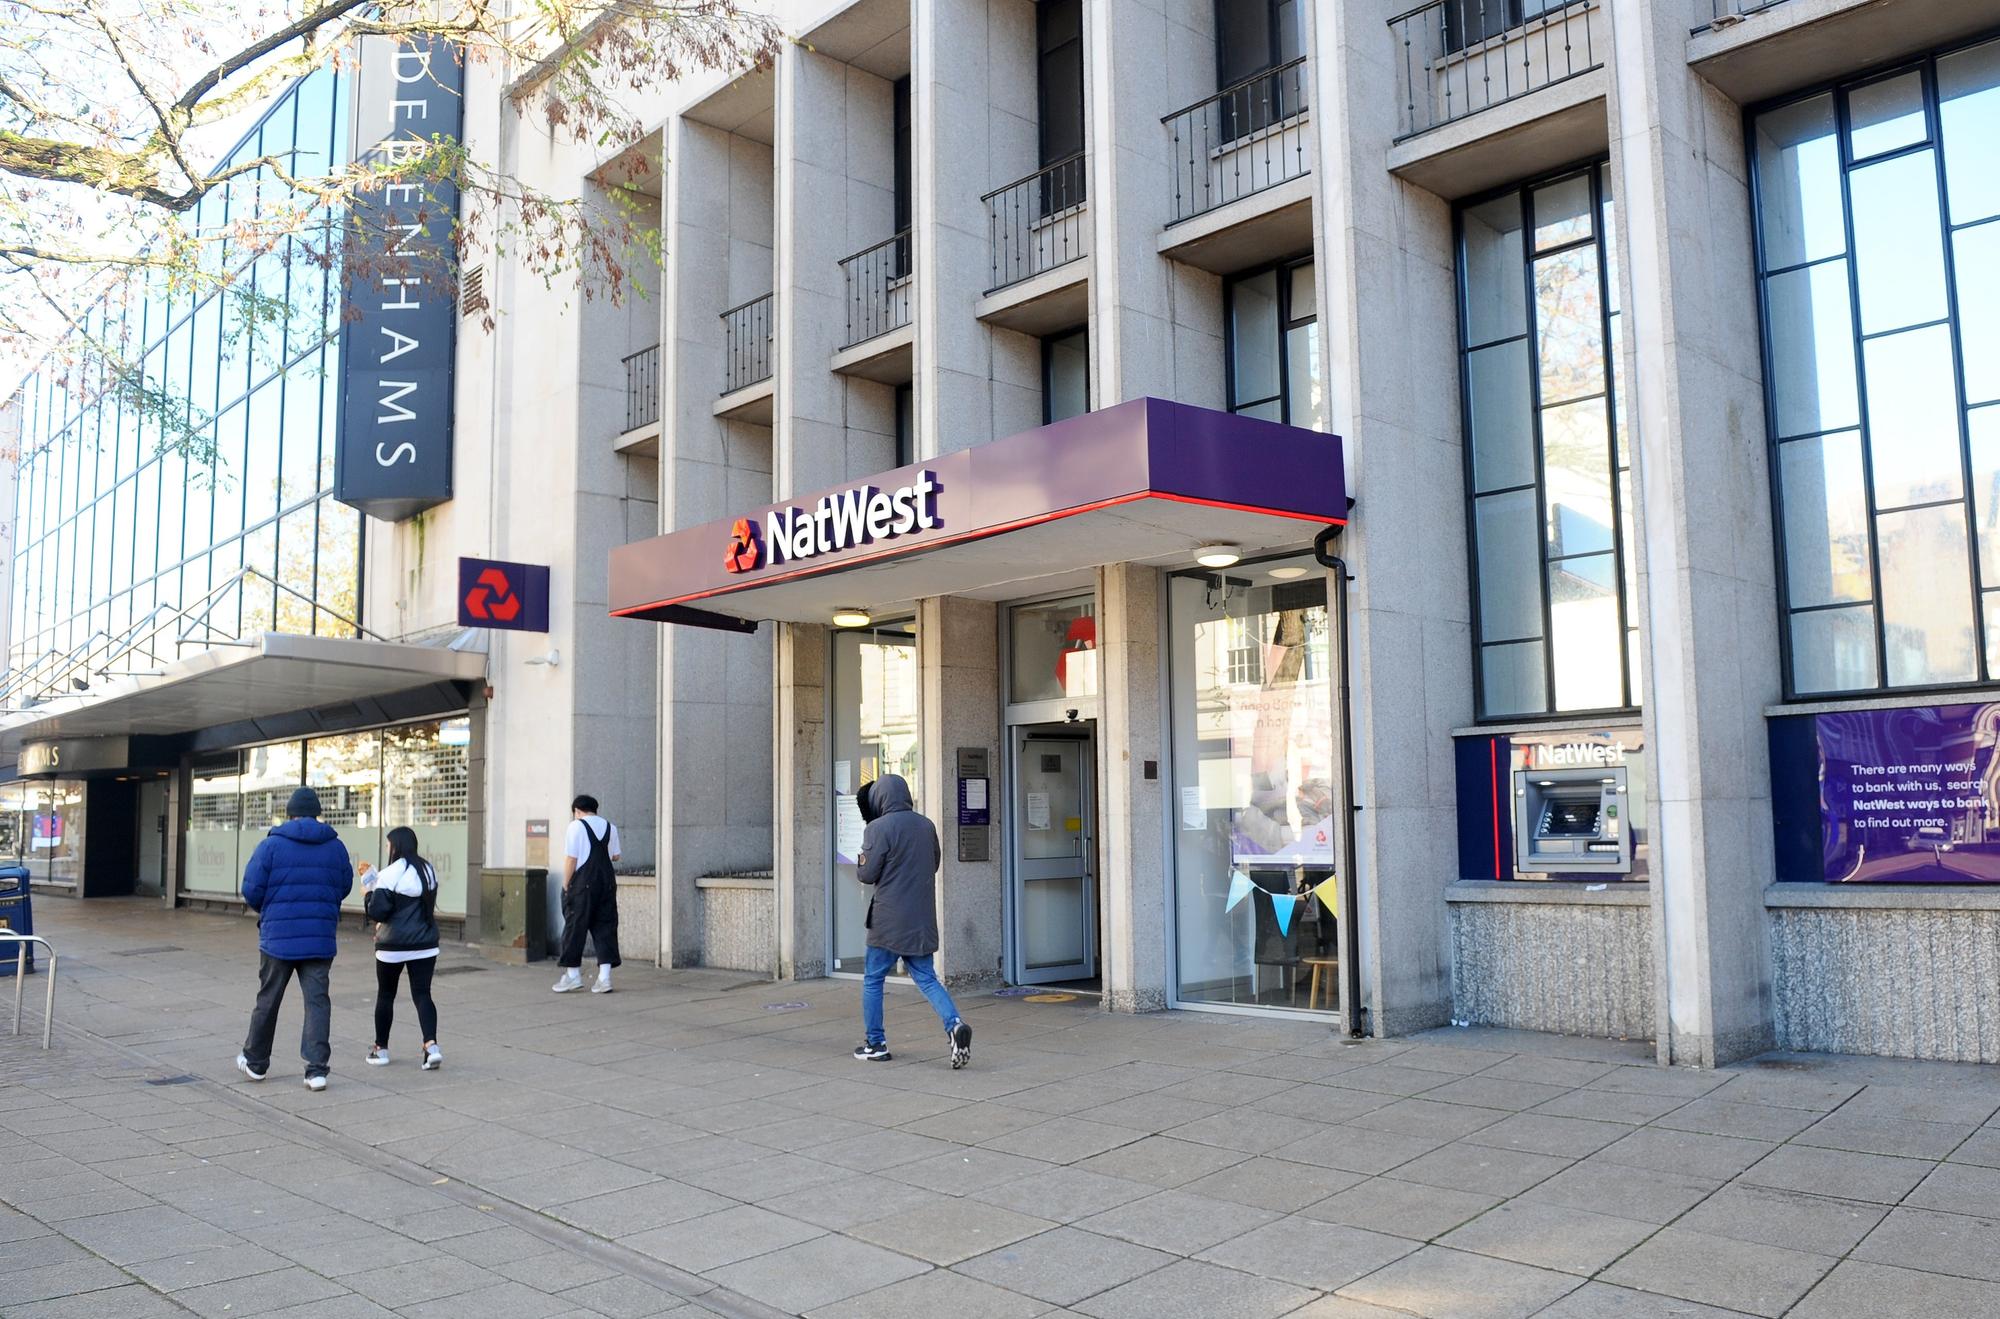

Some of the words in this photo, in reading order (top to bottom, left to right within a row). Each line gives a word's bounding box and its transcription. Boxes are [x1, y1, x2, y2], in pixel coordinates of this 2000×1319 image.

[375, 52, 430, 468] DEBENHAMS
[767, 470, 944, 565] NatWest
[1538, 741, 1626, 765] NatWest
[1851, 765, 1885, 775] There
[1887, 765, 1907, 774] are
[1909, 763, 1942, 774] many
[1945, 761, 1976, 774] ways
[1852, 784, 1864, 793] to
[1866, 782, 1895, 792] bank
[1896, 780, 1923, 791] with
[1925, 782, 1942, 791] us,
[1947, 778, 1989, 790] search
[1853, 799, 1905, 811] NatWest
[1907, 800, 1939, 811] ways
[1941, 798, 1955, 808] to
[1956, 797, 1988, 807] bank
[1854, 819, 1866, 828] to
[1868, 817, 1890, 827] find
[1892, 817, 1912, 827] out
[1913, 817, 1948, 827] more.
